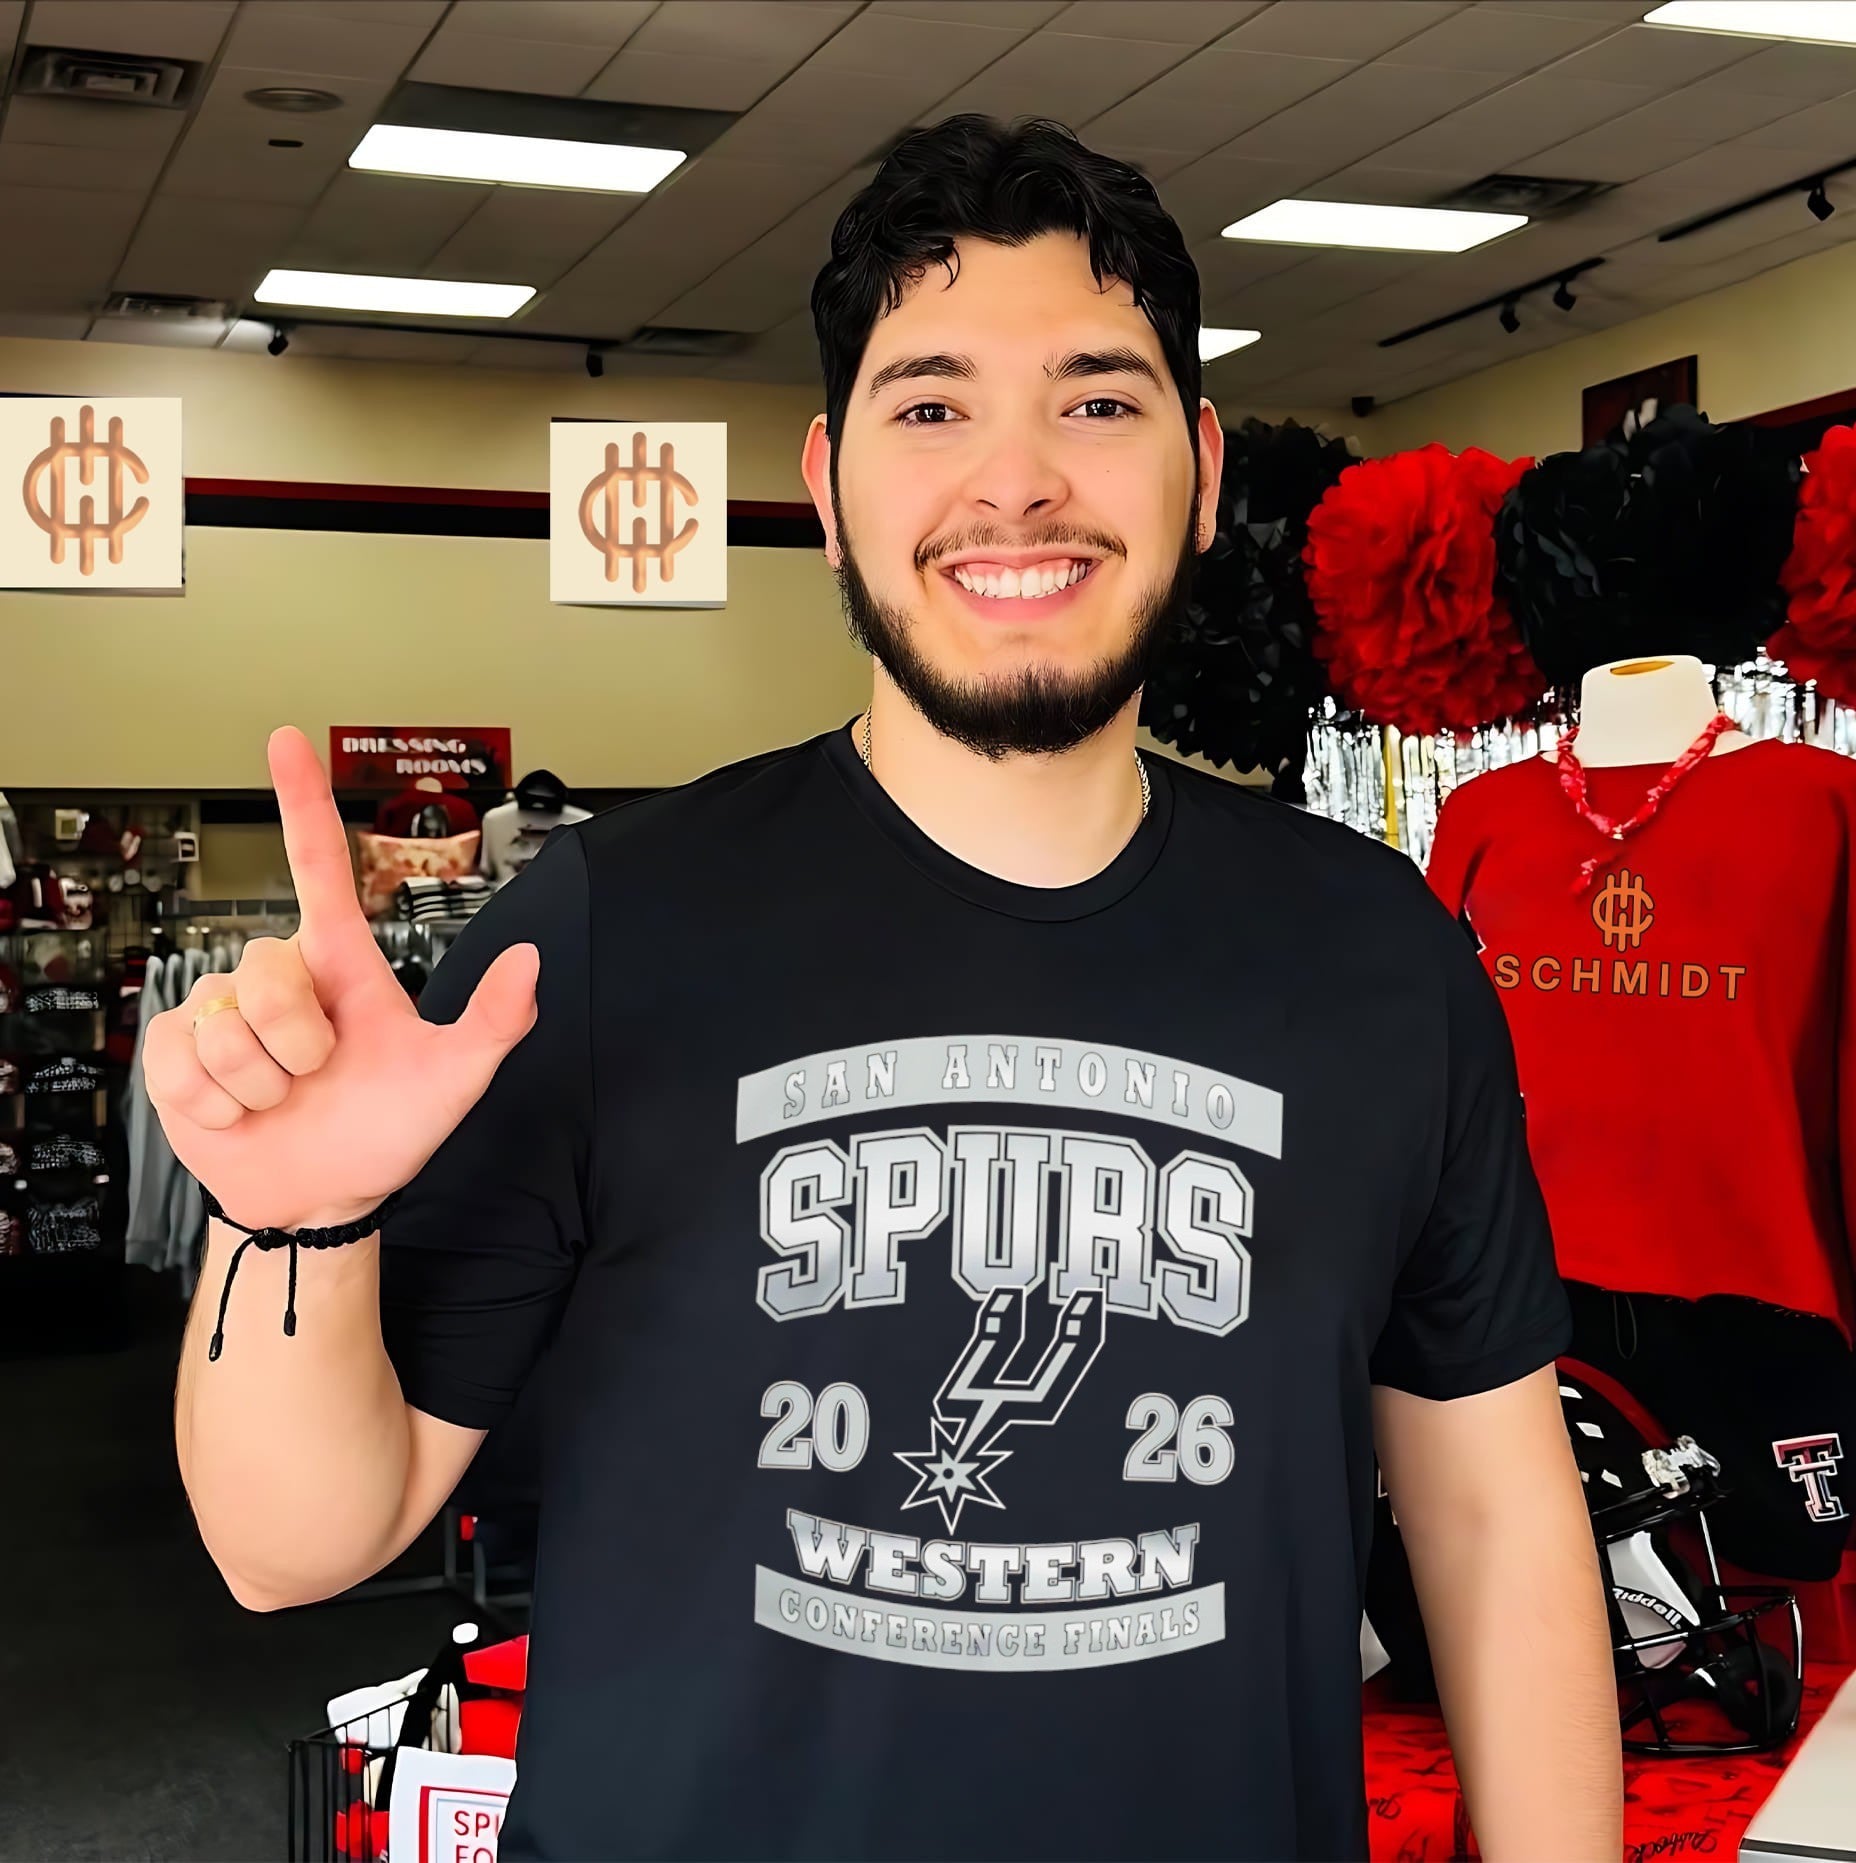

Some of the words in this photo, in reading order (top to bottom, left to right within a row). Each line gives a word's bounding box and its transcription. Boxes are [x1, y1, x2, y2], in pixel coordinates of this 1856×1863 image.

[342, 737, 467, 754] DRESSING
[396, 758, 487, 775] ROOMS
[1493, 953, 1748, 1000] SCHMIDT
[783, 1051, 898, 1119] SAN
[941, 1044, 1236, 1130] ANTONIO
[756, 1125, 1254, 1337] SPURS
[757, 1380, 870, 1472] 20
[1123, 1392, 1236, 1485] 26
[786, 1507, 1200, 1604] WESTERN
[778, 1588, 1047, 1658] CONFERENCE
[1062, 1600, 1201, 1656] FINALS
